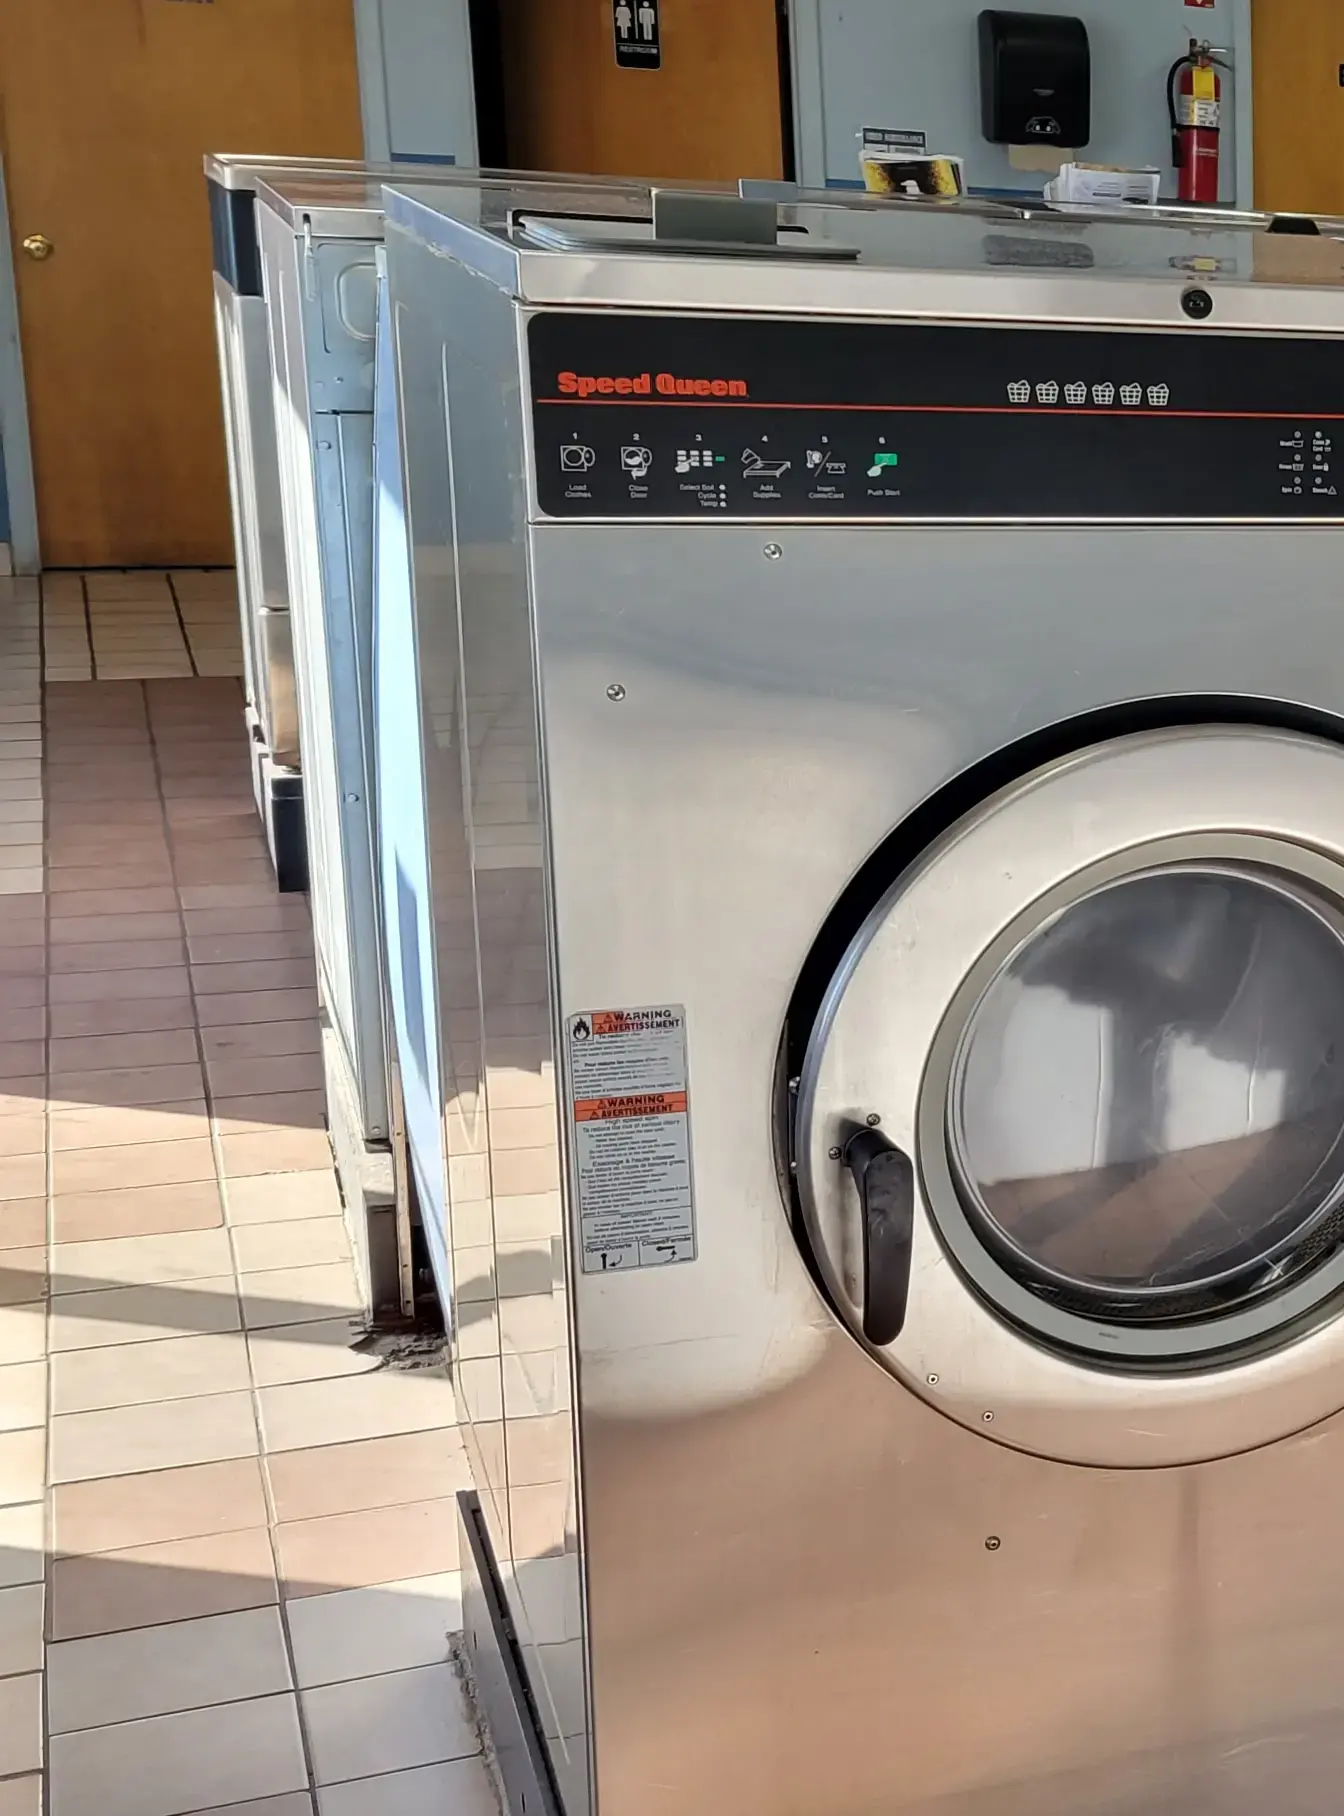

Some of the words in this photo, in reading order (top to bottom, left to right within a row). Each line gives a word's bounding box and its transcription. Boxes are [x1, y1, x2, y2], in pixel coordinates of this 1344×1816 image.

[558, 372, 650, 397] Speed
[656, 373, 747, 396] Queen
[615, 1009, 672, 1021] WARNING
[608, 1019, 680, 1032] AVERTISSEMENT
[607, 1094, 665, 1108] WARNING
[601, 1104, 673, 1120] AVERTISSEMENT
